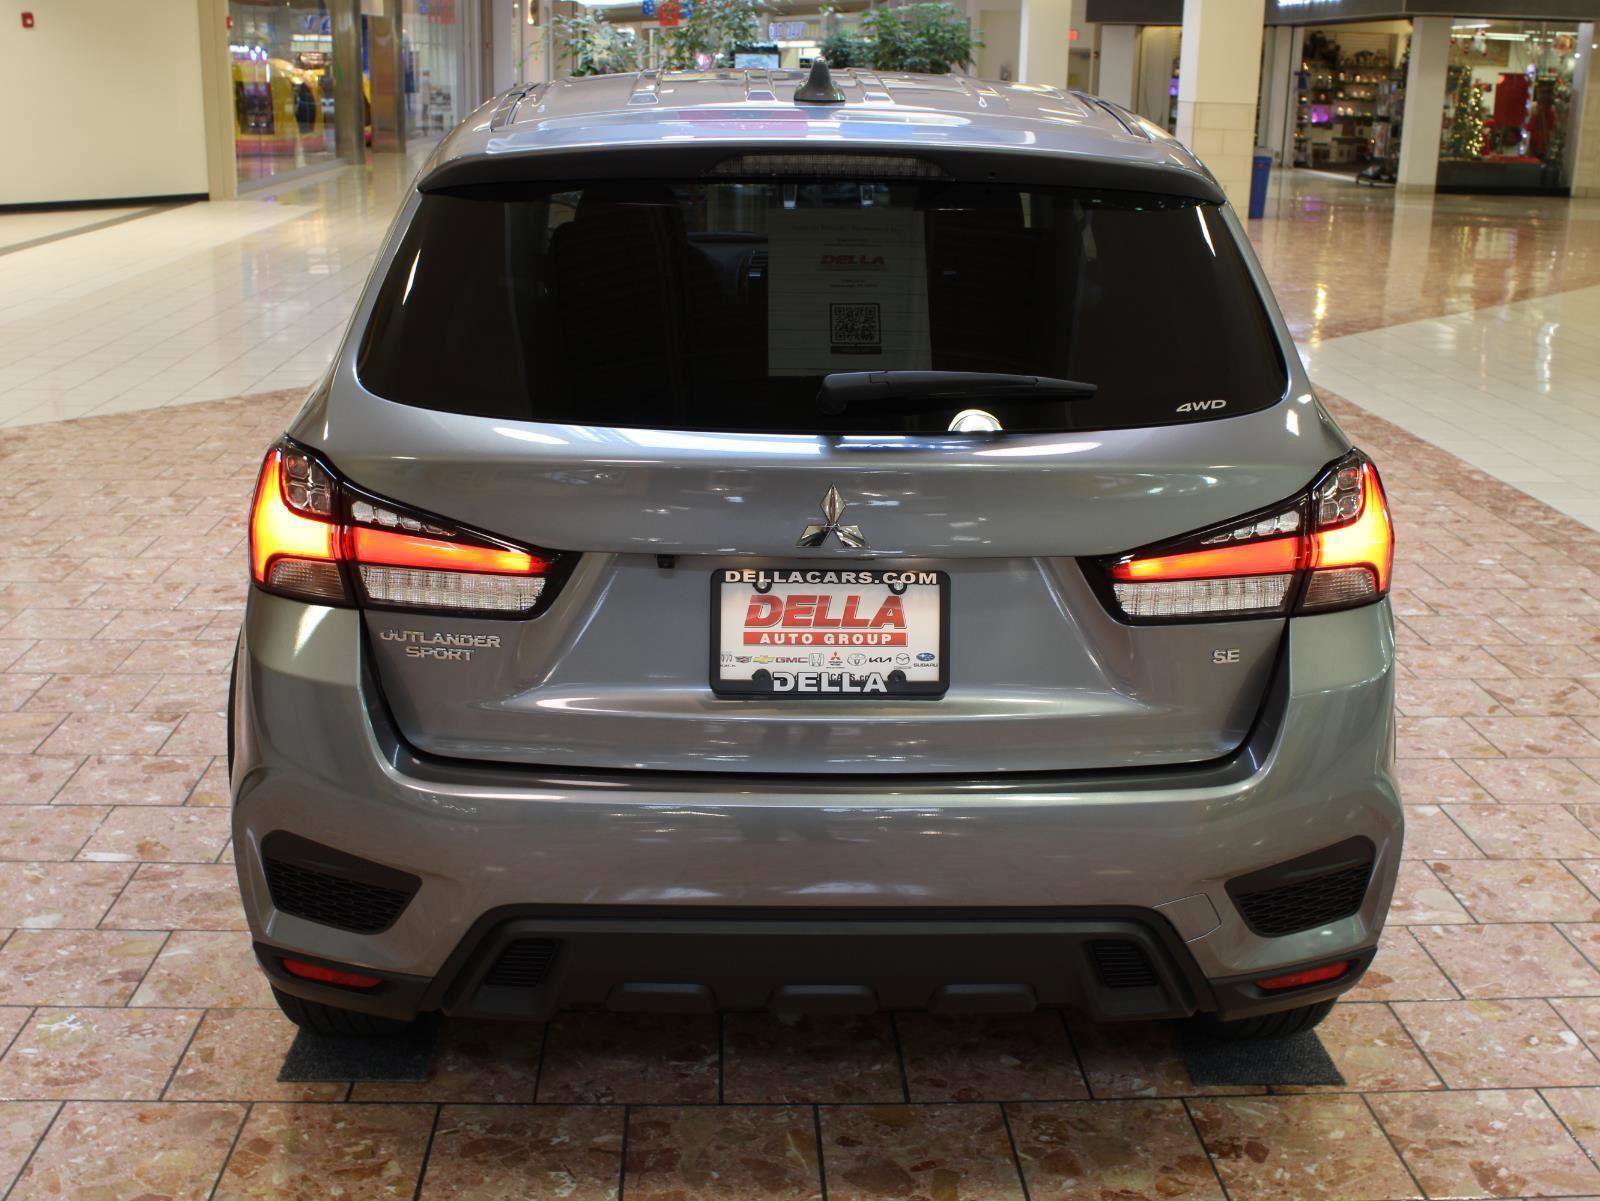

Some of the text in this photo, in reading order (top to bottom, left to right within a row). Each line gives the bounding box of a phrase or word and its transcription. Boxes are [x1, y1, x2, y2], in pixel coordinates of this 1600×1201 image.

[820, 254, 885, 265] DELLA
[1176, 399, 1227, 413] 4WD
[724, 570, 938, 585] DELLACARS.COM
[743, 594, 908, 629] DELLA
[379, 629, 501, 648] OUTLANDER
[759, 633, 892, 645] AUTO GROUP
[405, 645, 475, 661] SPORT
[775, 656, 809, 664] GMC
[1212, 649, 1240, 664] SE
[772, 671, 888, 693] DELLA
